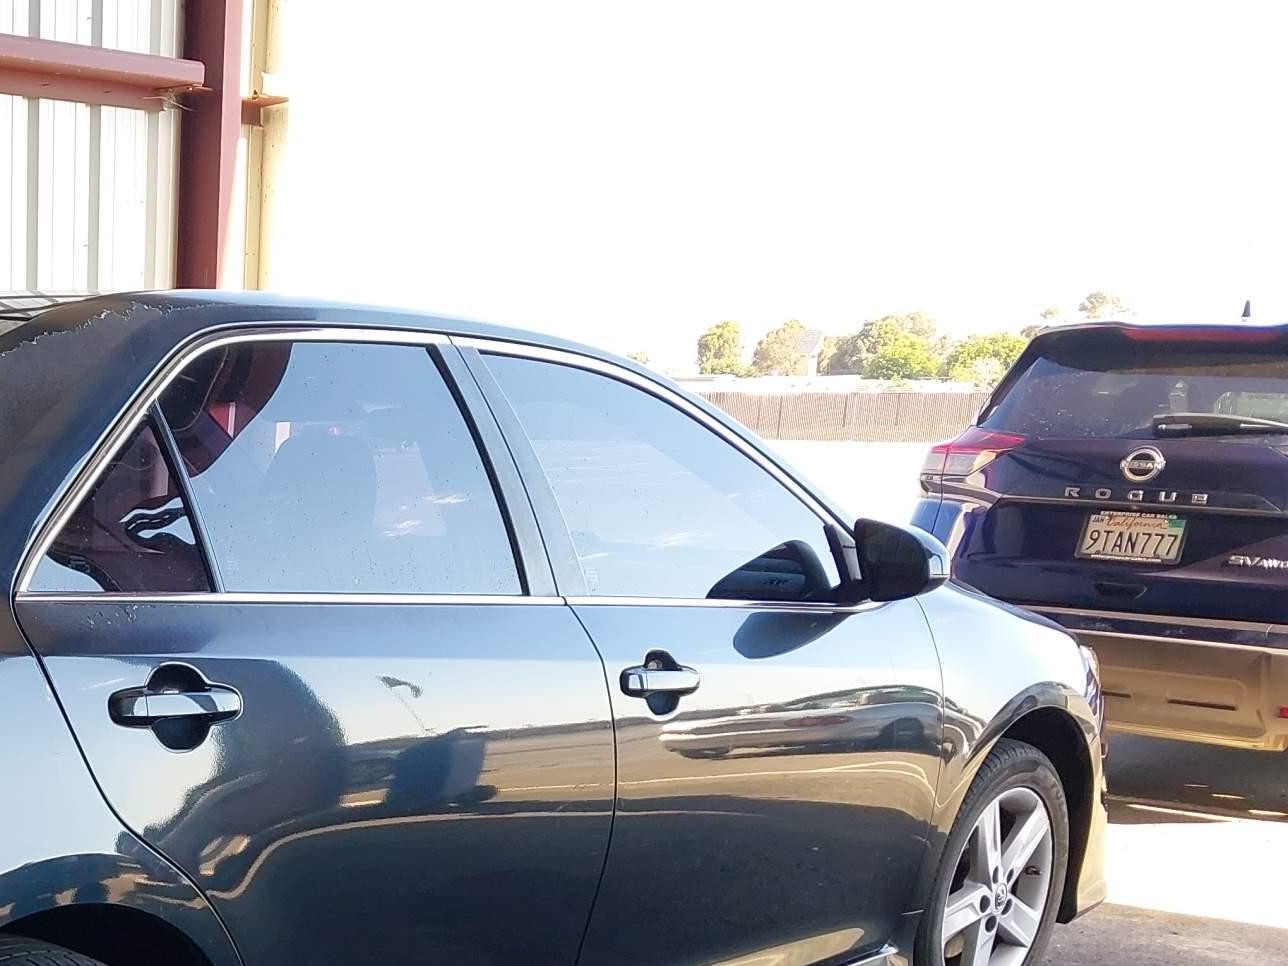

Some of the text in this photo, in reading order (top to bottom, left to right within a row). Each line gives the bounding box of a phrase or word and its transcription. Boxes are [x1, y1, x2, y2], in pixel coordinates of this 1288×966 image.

[1121, 459, 1165, 470] NISSAN
[1064, 486, 1209, 505] ROGUE
[1100, 510, 1140, 518] ENTERPRISE
[1106, 515, 1168, 531] California
[1085, 529, 1179, 556] 9TAN777
